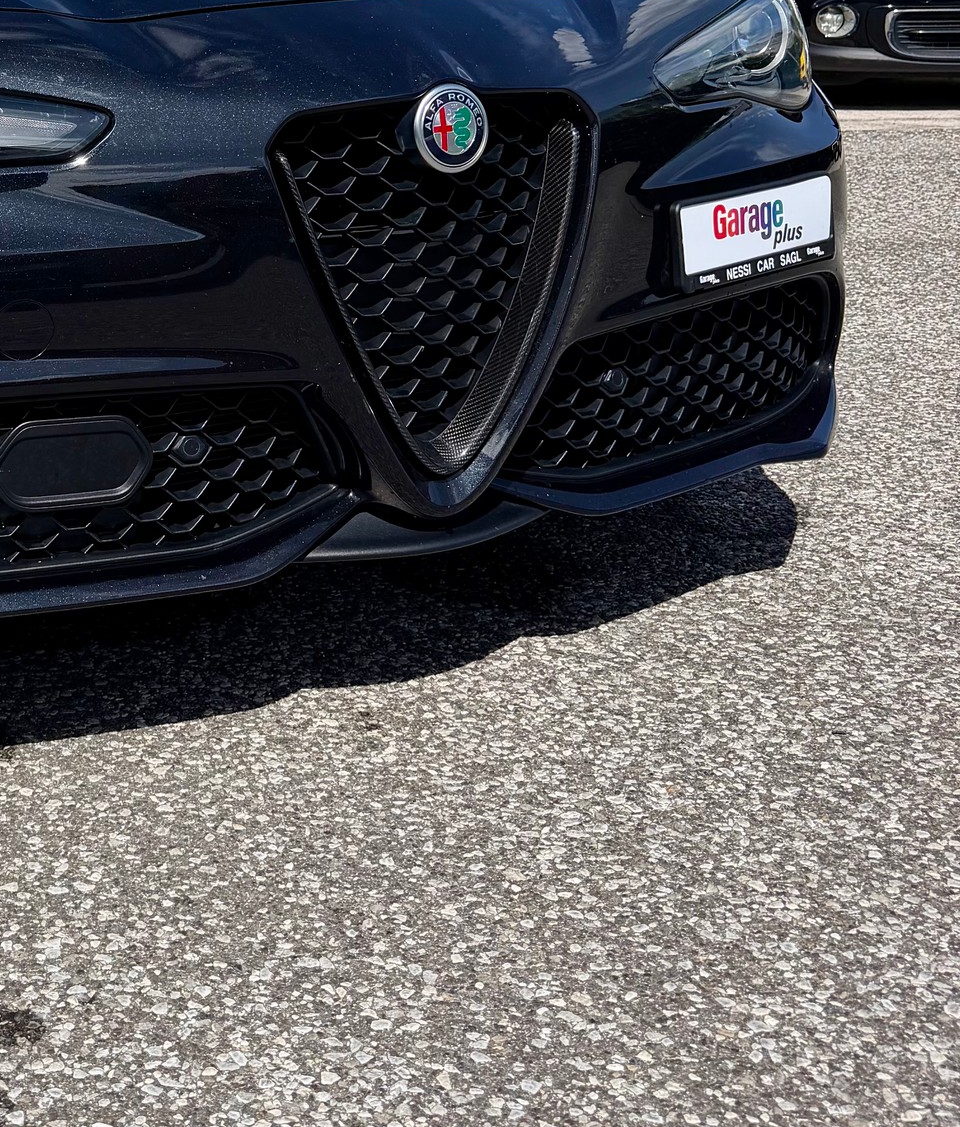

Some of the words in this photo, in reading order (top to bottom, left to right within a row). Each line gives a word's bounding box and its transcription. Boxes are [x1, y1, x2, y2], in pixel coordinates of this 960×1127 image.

[424, 99, 444, 131] ALFA
[448, 93, 483, 127] ROMEO
[713, 199, 784, 240] Garage
[773, 224, 803, 249] plus
[726, 263, 752, 280] NESSI
[757, 257, 775, 272] CAR
[780, 251, 802, 266] SAGL
